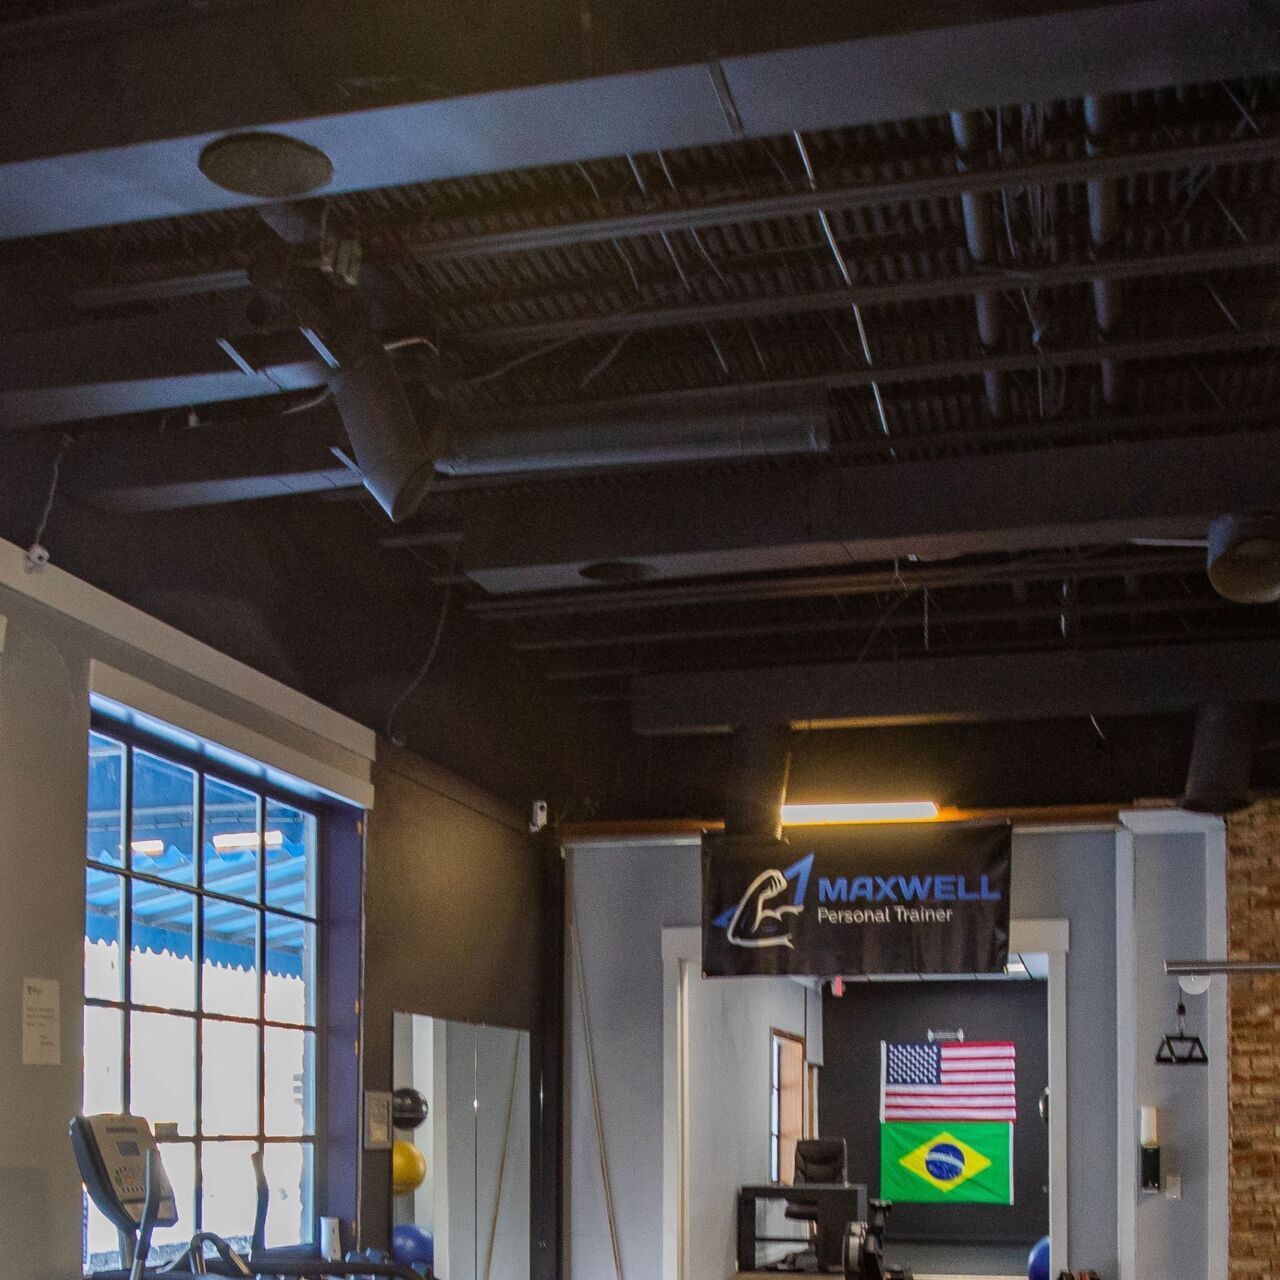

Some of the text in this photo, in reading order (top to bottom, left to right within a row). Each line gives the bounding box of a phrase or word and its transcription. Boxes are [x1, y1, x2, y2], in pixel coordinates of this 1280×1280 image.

[818, 875, 1001, 902] MAXWELL
[817, 904, 953, 924] Personal Trainer
